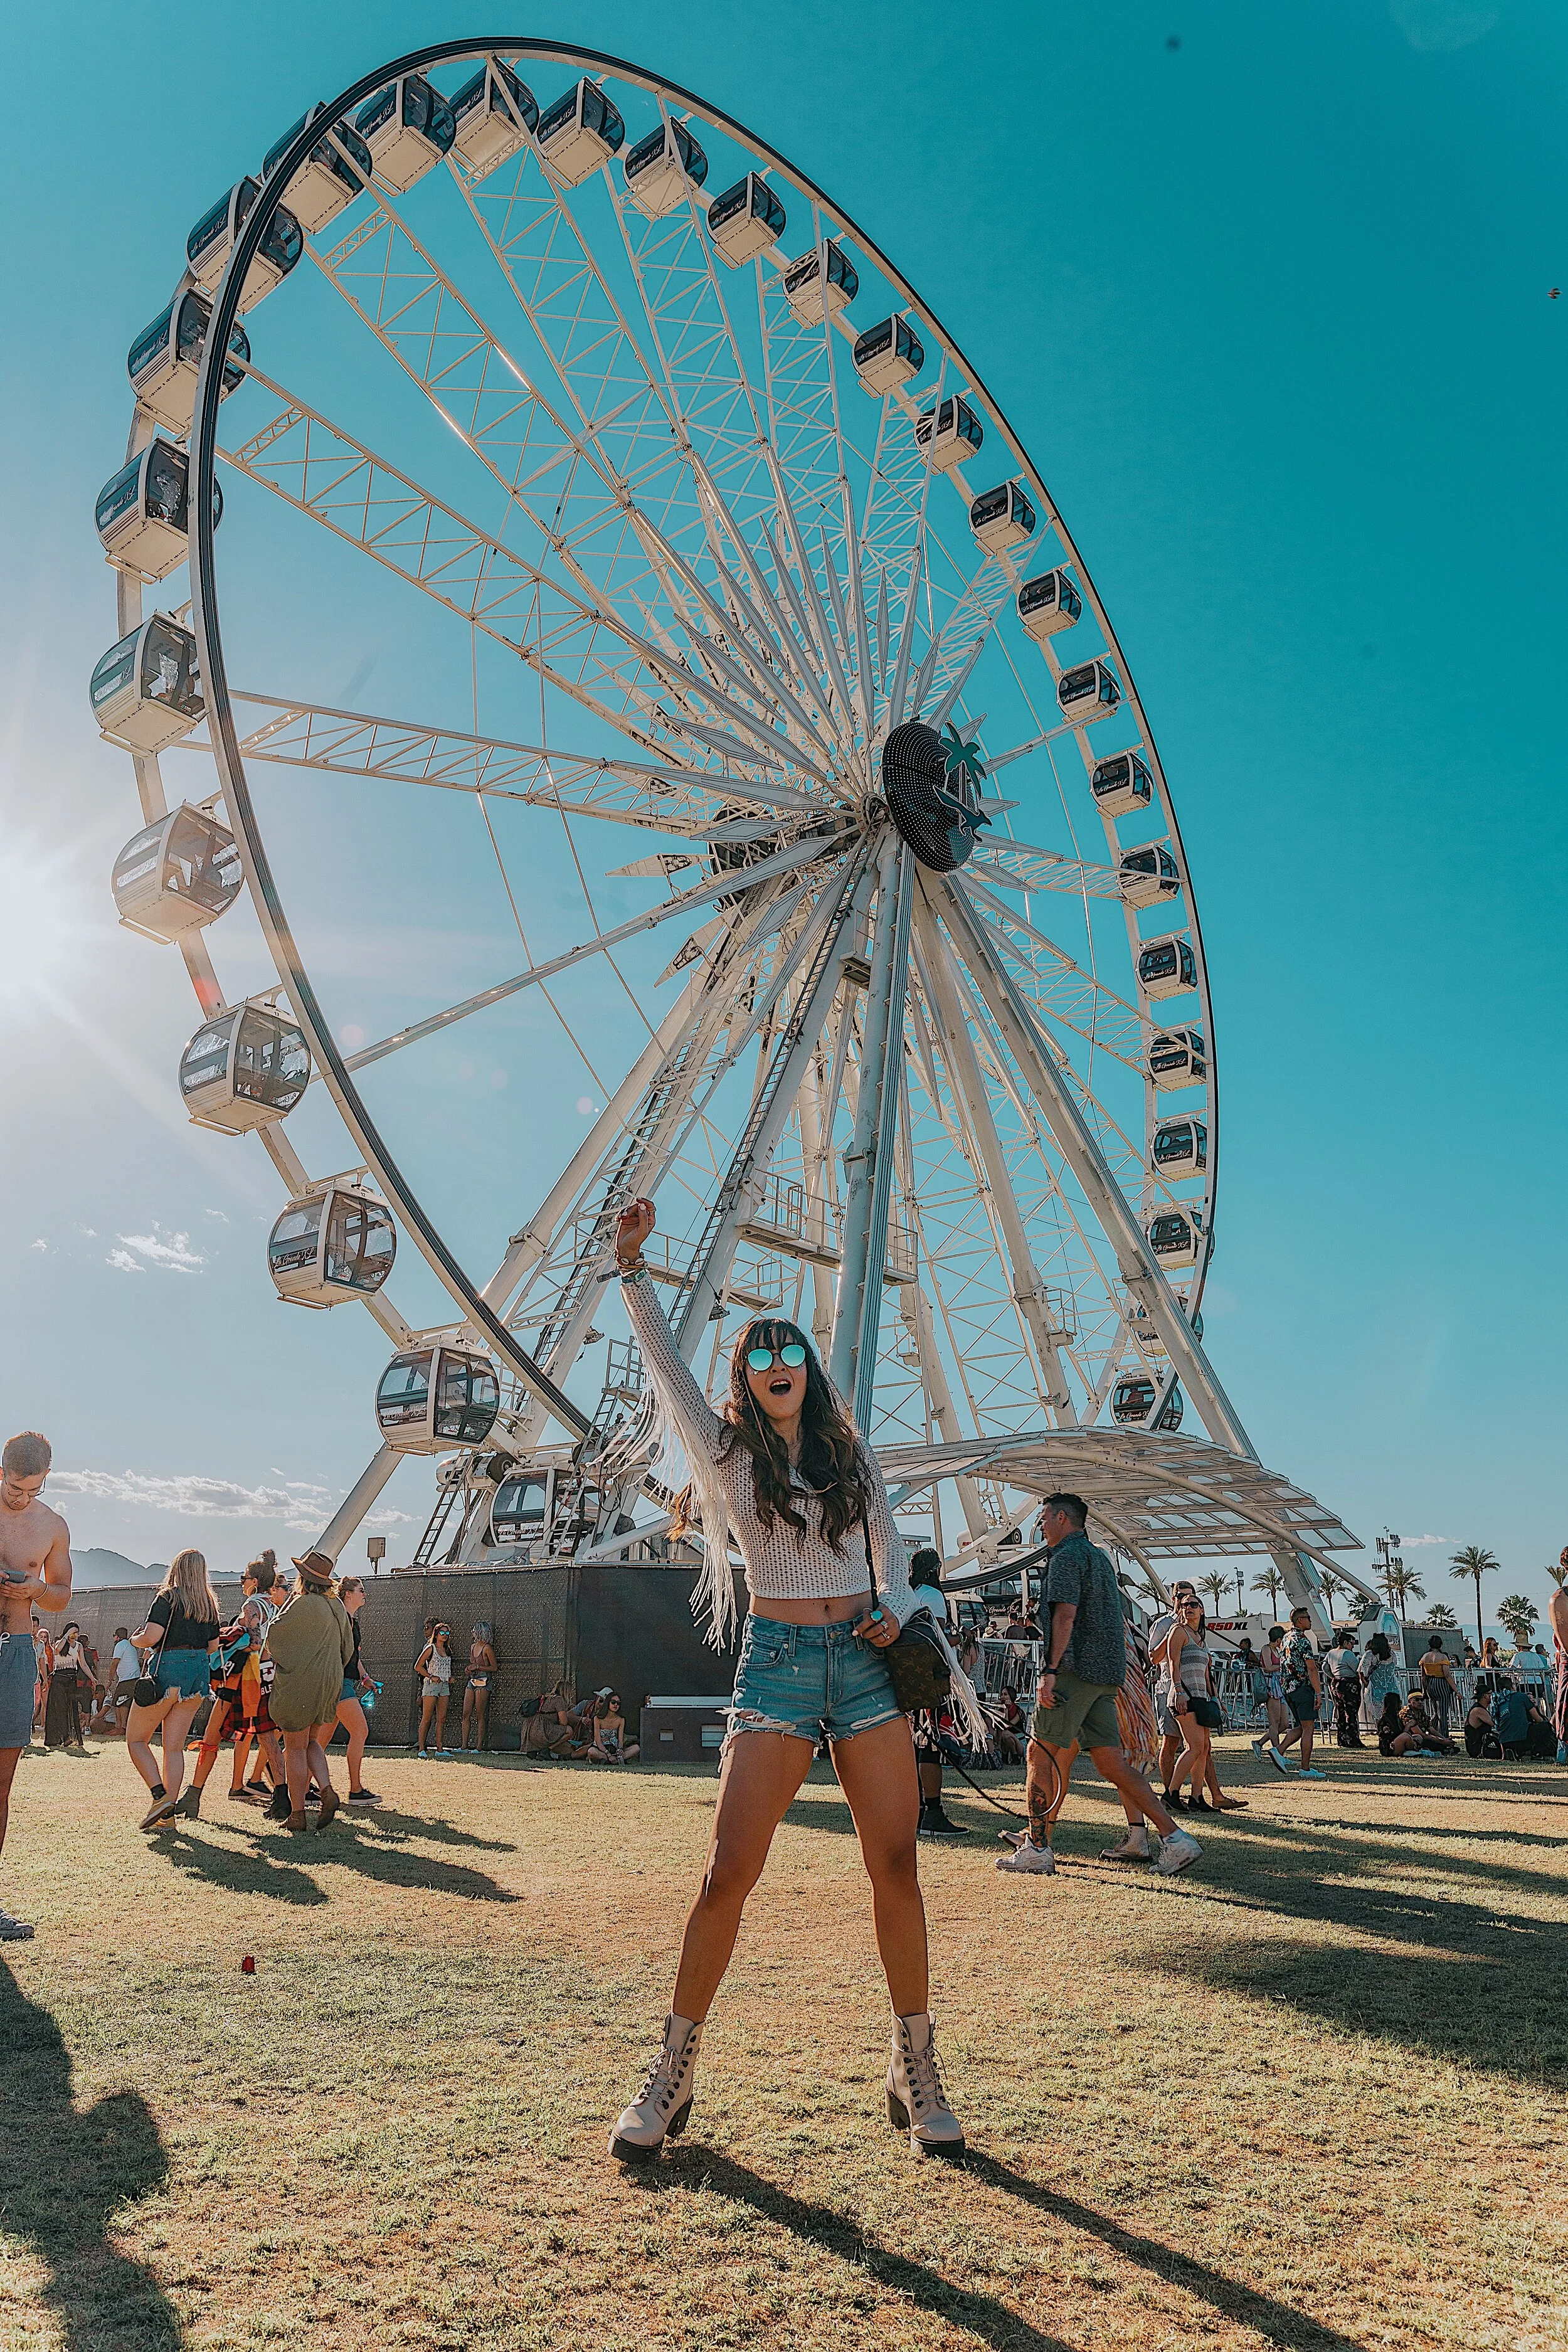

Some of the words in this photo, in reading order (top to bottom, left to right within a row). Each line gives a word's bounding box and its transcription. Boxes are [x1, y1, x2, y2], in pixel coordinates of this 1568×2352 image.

[471, 88, 483, 105] XL
[383, 100, 394, 119] XL
[282, 1253, 302, 1266] Grande
[301, 1246, 315, 1260] XL
[988, 1605, 1007, 1614] Grande
[1007, 1605, 1019, 1614] XL
